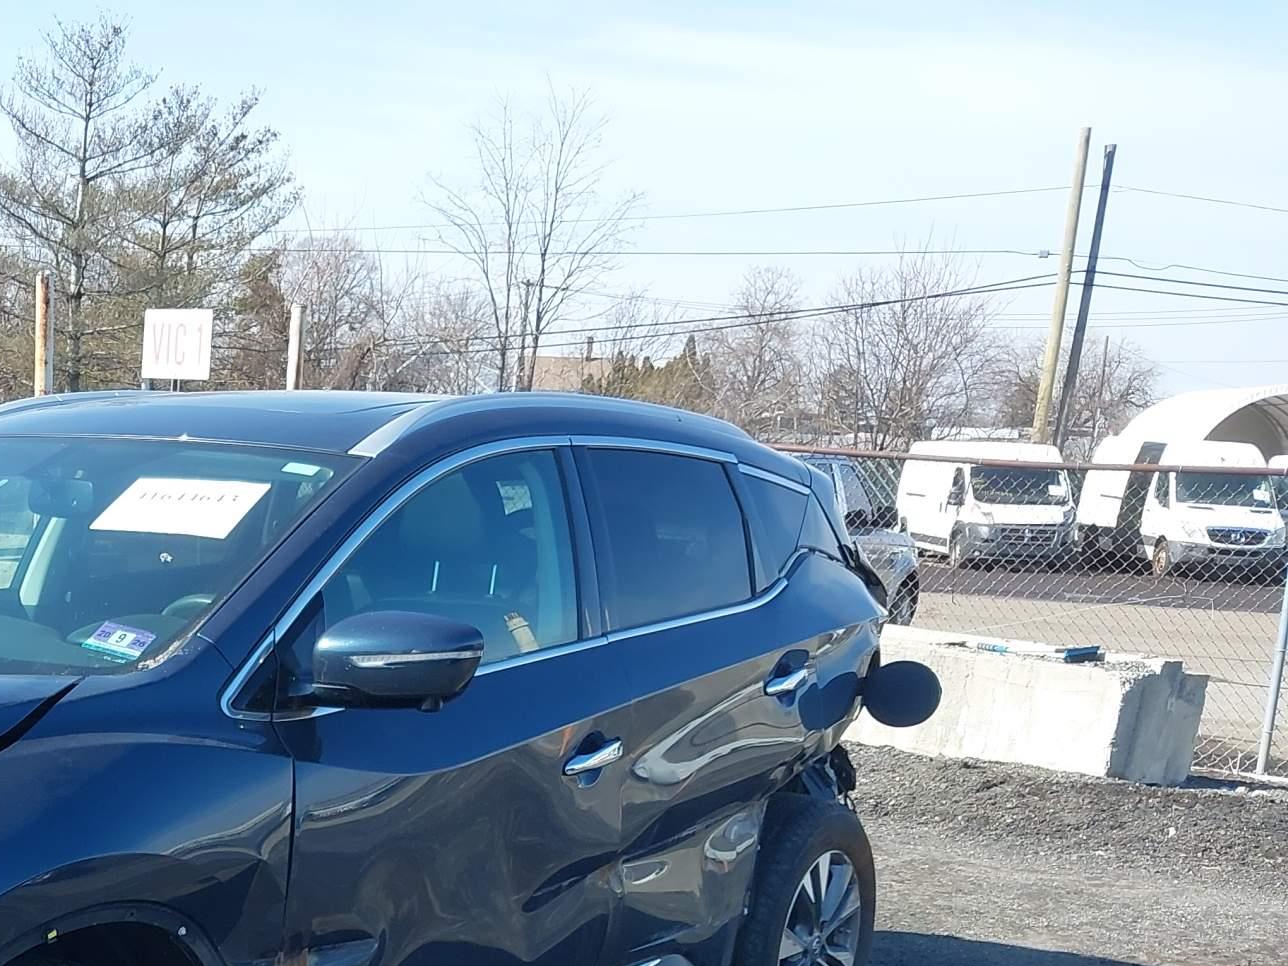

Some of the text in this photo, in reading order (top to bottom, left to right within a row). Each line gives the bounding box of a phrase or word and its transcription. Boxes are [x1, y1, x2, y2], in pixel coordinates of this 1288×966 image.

[153, 322, 203, 366] VIC 1
[116, 633, 127, 644] 9
